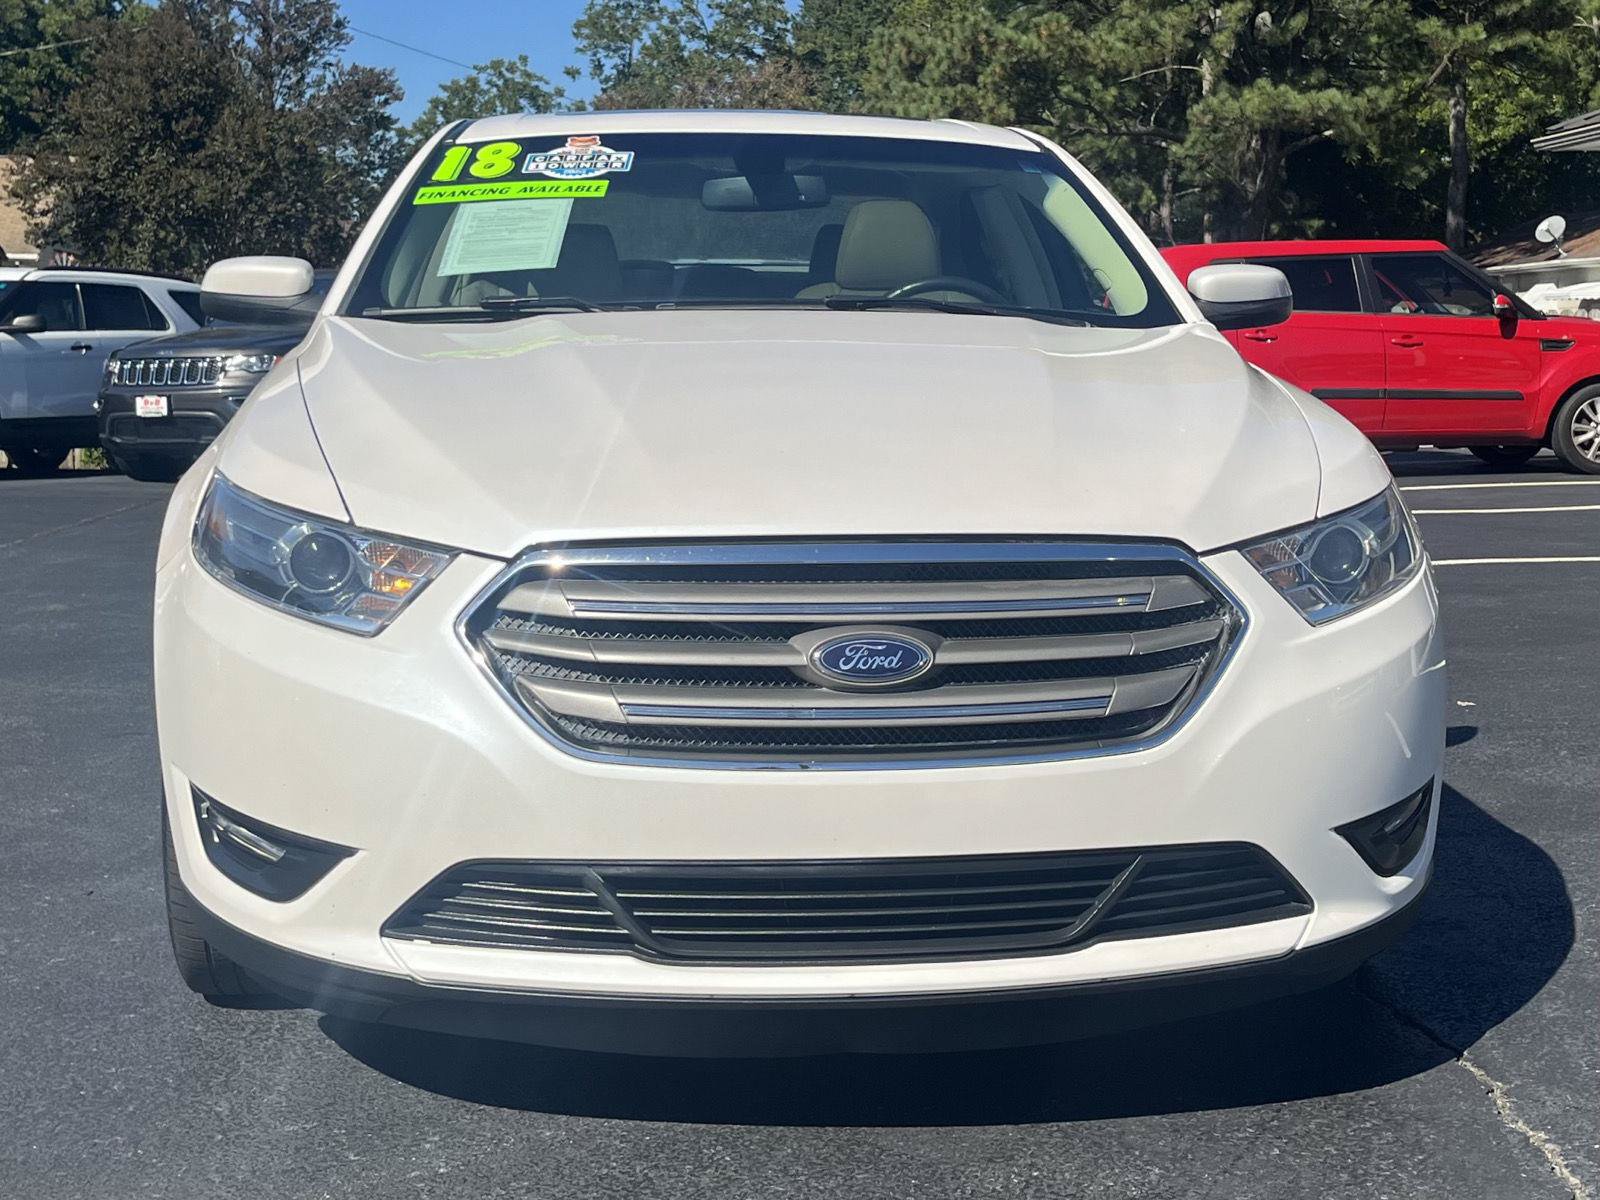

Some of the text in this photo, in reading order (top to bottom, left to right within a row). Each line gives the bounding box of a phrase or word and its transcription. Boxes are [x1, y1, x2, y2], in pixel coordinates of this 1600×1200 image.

[432, 142, 522, 181] 18
[534, 154, 624, 163] CARFAX
[418, 183, 604, 200] FINANCING AVAILABLE
[839, 643, 902, 670] Ford
